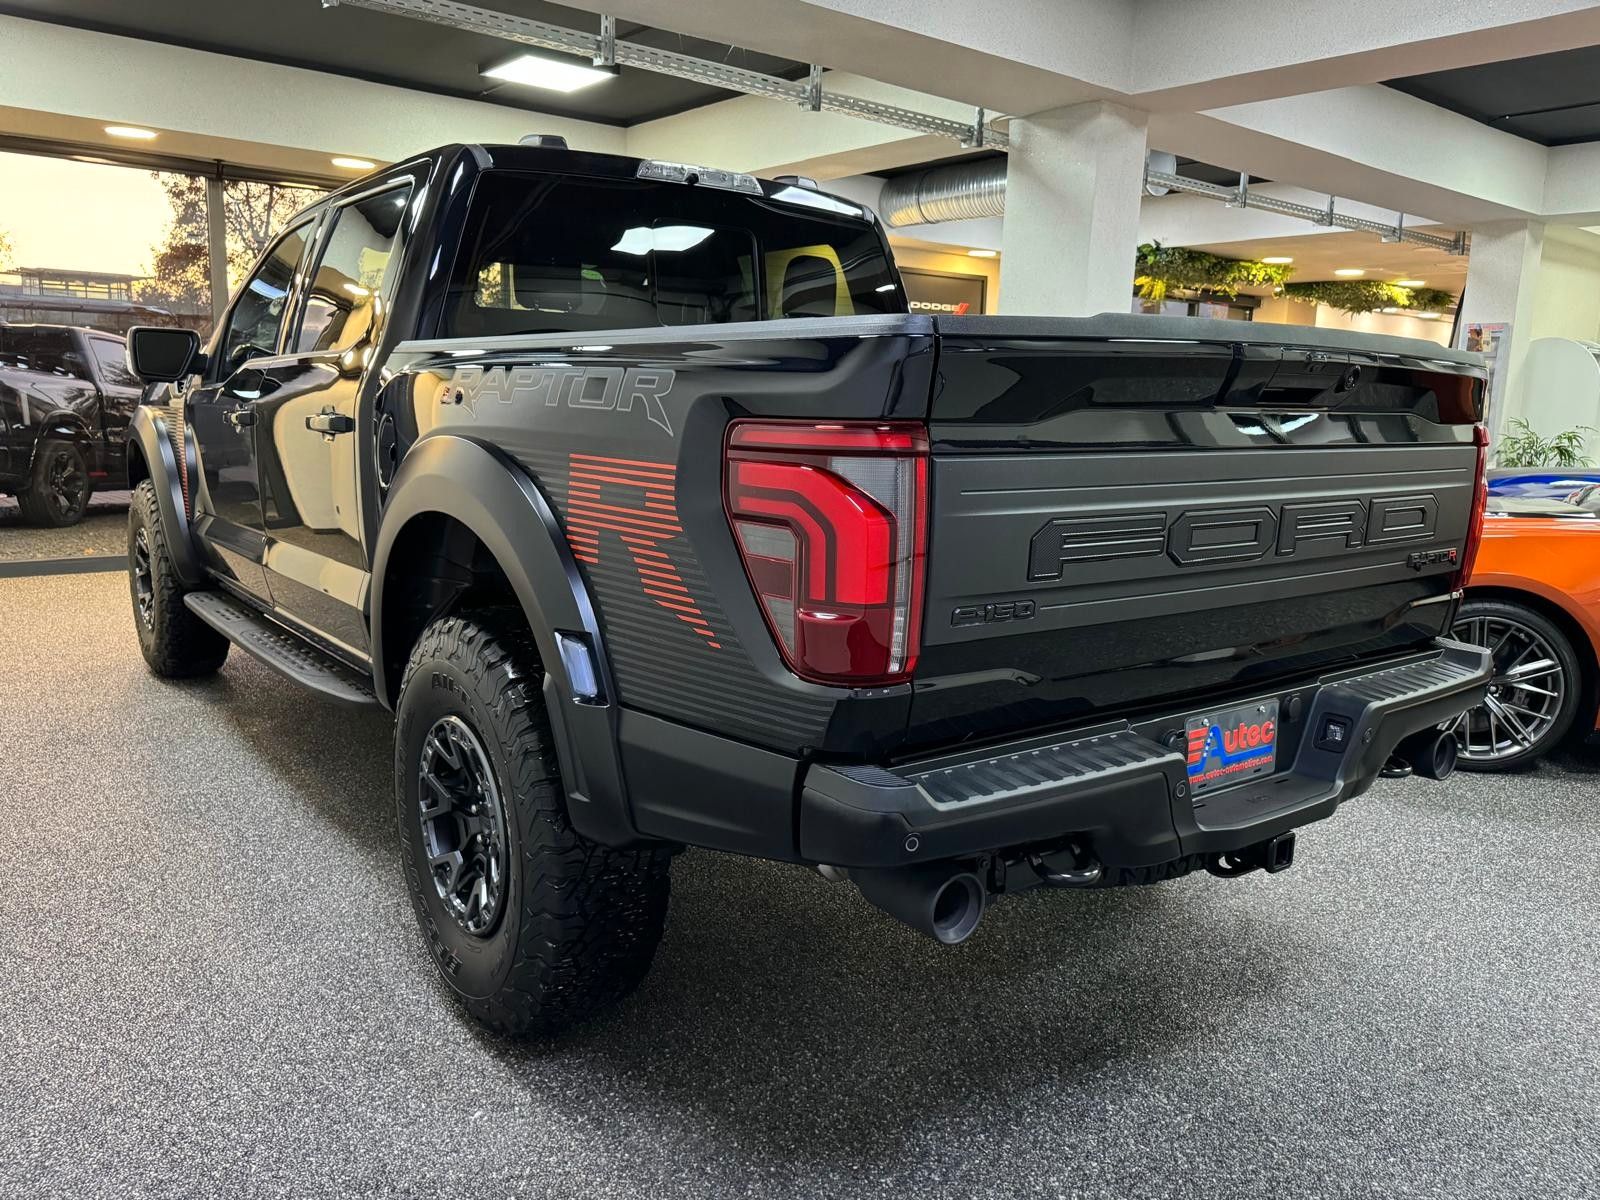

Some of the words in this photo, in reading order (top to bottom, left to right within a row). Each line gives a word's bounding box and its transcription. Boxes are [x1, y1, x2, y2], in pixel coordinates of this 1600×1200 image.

[910, 301, 960, 312] DODGE
[450, 365, 676, 437] RAPTOR
[1029, 494, 1439, 581] FORD
[950, 599, 1036, 628] F-150
